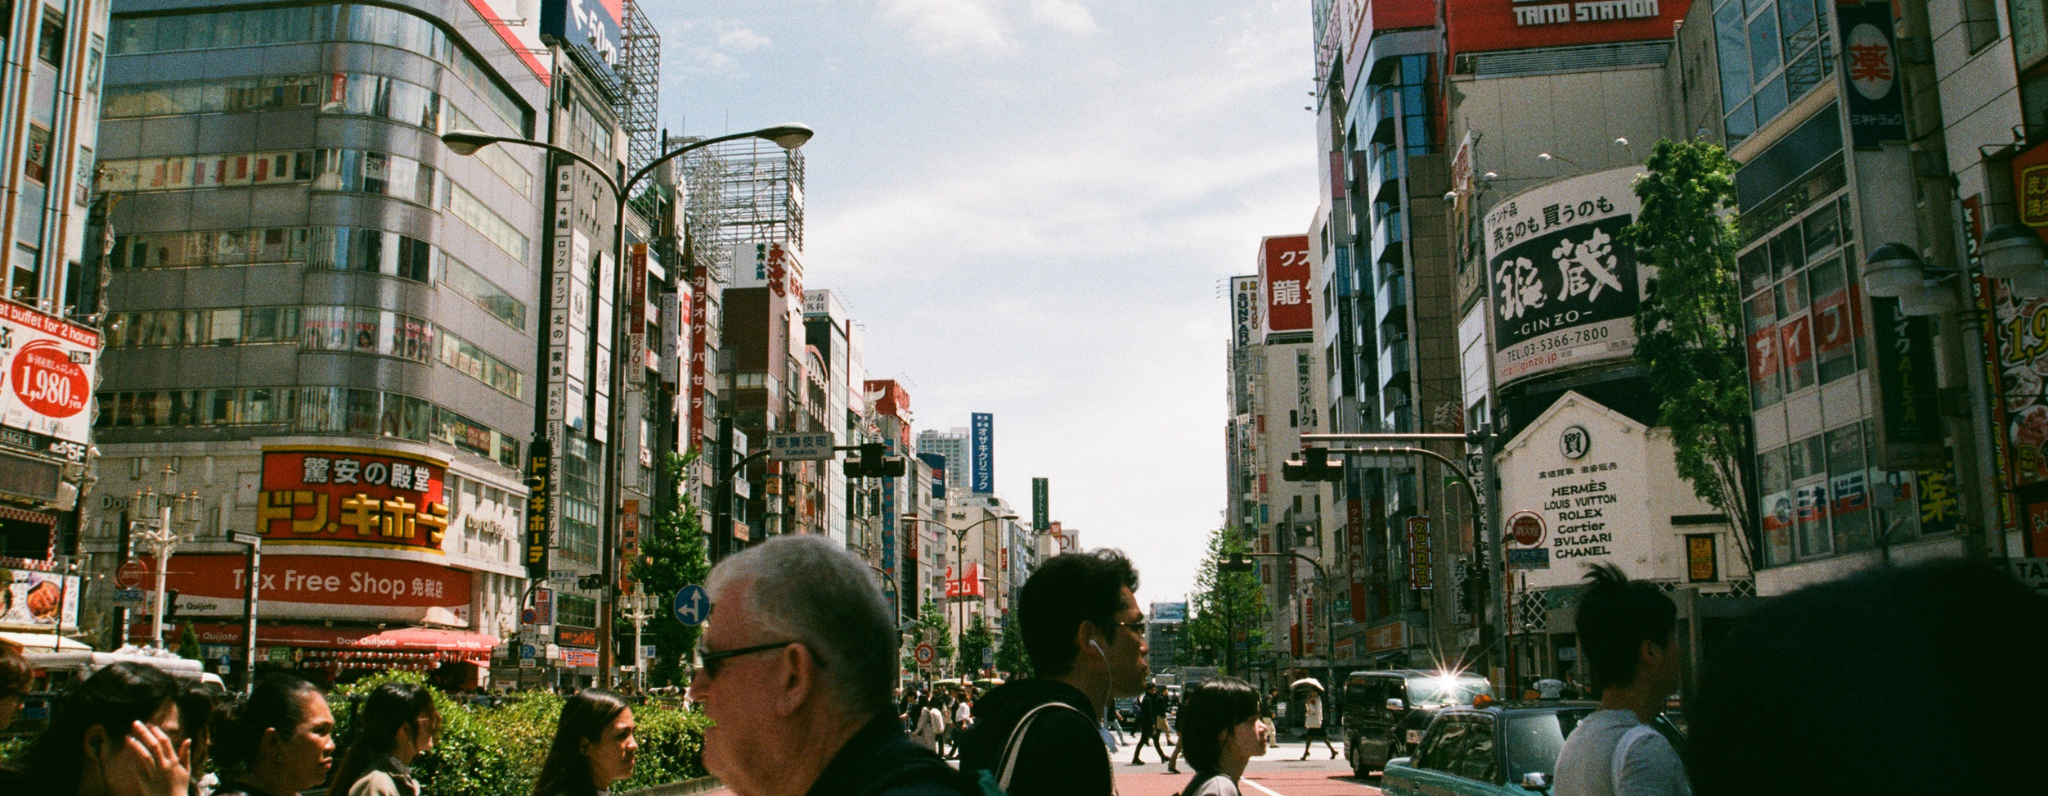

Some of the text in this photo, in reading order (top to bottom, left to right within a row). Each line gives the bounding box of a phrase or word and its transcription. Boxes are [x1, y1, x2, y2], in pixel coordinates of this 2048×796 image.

[1512, 0, 1660, 26] TAITO STATION
[588, 9, 618, 70] 50m
[1851, 43, 1892, 82] 薬
[1487, 201, 1519, 232] ブランド品
[555, 240, 566, 304] ロックアップ
[693, 275, 705, 335] カラオケ
[1341, 301, 1349, 315] DIET
[11, 305, 42, 329] buffet
[44, 317, 59, 333] for
[61, 324, 68, 336] 2
[69, 326, 97, 347] hours
[1893, 305, 1913, 355] レイク
[551, 315, 565, 377] 北の家族
[20, 366, 83, 410] 1,980 yen
[691, 352, 705, 409] パセラ
[775, 435, 828, 449] 歌舞伎町
[978, 428, 988, 490] オザキクリニック
[303, 456, 431, 493] 驚安の殿堂
[1538, 467, 1575, 480] 高価買取
[1551, 479, 1608, 498] HERMÈS
[1544, 493, 1617, 511] LOUIS VUITTON
[1559, 508, 1604, 522] ROLEX
[1553, 533, 1613, 548] BVLGARI
[1557, 522, 1606, 535] Cartier
[1414, 521, 1428, 585] ネットカフェ
[1555, 546, 1611, 560] CHANEL
[2016, 562, 2048, 579] TA
[232, 569, 406, 600] Tx Free Shop
[411, 577, 443, 599] 免税店
[186, 601, 217, 612] Quijote
[203, 631, 239, 643] Quijote
[336, 636, 397, 648] Don Quijote
